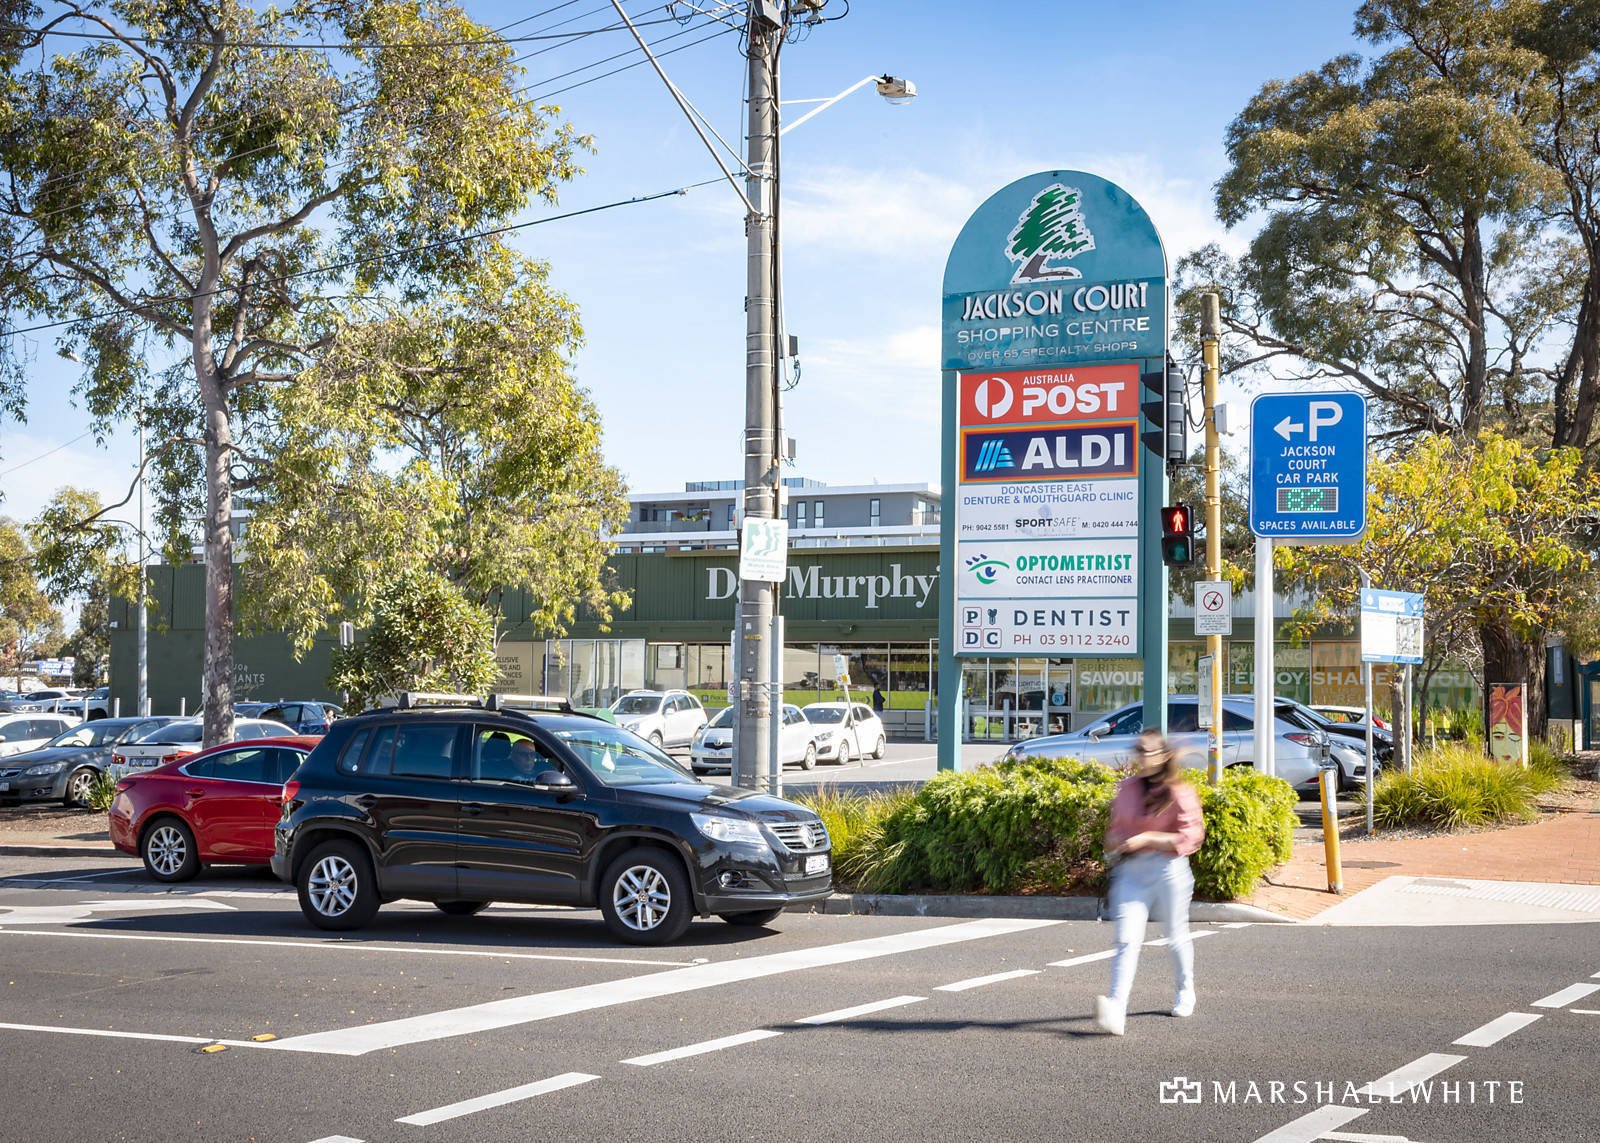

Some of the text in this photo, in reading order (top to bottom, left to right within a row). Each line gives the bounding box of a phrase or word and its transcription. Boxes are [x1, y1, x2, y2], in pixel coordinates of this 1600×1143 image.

[961, 282, 1148, 321] JACKSON COURT
[957, 316, 1150, 343] SHOPPING CENTRE
[968, 341, 1138, 361] OVER 65 SPECIALTY SHOPS
[1023, 373, 1075, 386] AUSTRALIA
[1022, 382, 1125, 417] POST
[1308, 400, 1343, 442] P
[1021, 433, 1125, 470] ALDI
[1280, 446, 1336, 457] JACKSON
[1288, 459, 1327, 470] COURT
[1276, 472, 1339, 484] CAR PARK
[1001, 483, 1094, 495] DONCASTER EAST
[963, 492, 1134, 505] DENTURE & MOUTHGUARD CLINIC
[1287, 488, 1324, 511] 82
[1259, 520, 1356, 530] SPACES AVAILABLE
[1016, 554, 1132, 571] OPTOMETRIST
[1016, 575, 1132, 584] CONTACT LENS PRACTITIONER
[966, 611, 979, 624] P
[1013, 610, 1130, 626] DENTIST
[966, 632, 998, 645] D C
[1013, 634, 1130, 645] PH 03 9112 3240
[1080, 663, 1124, 672] SPIRITS
